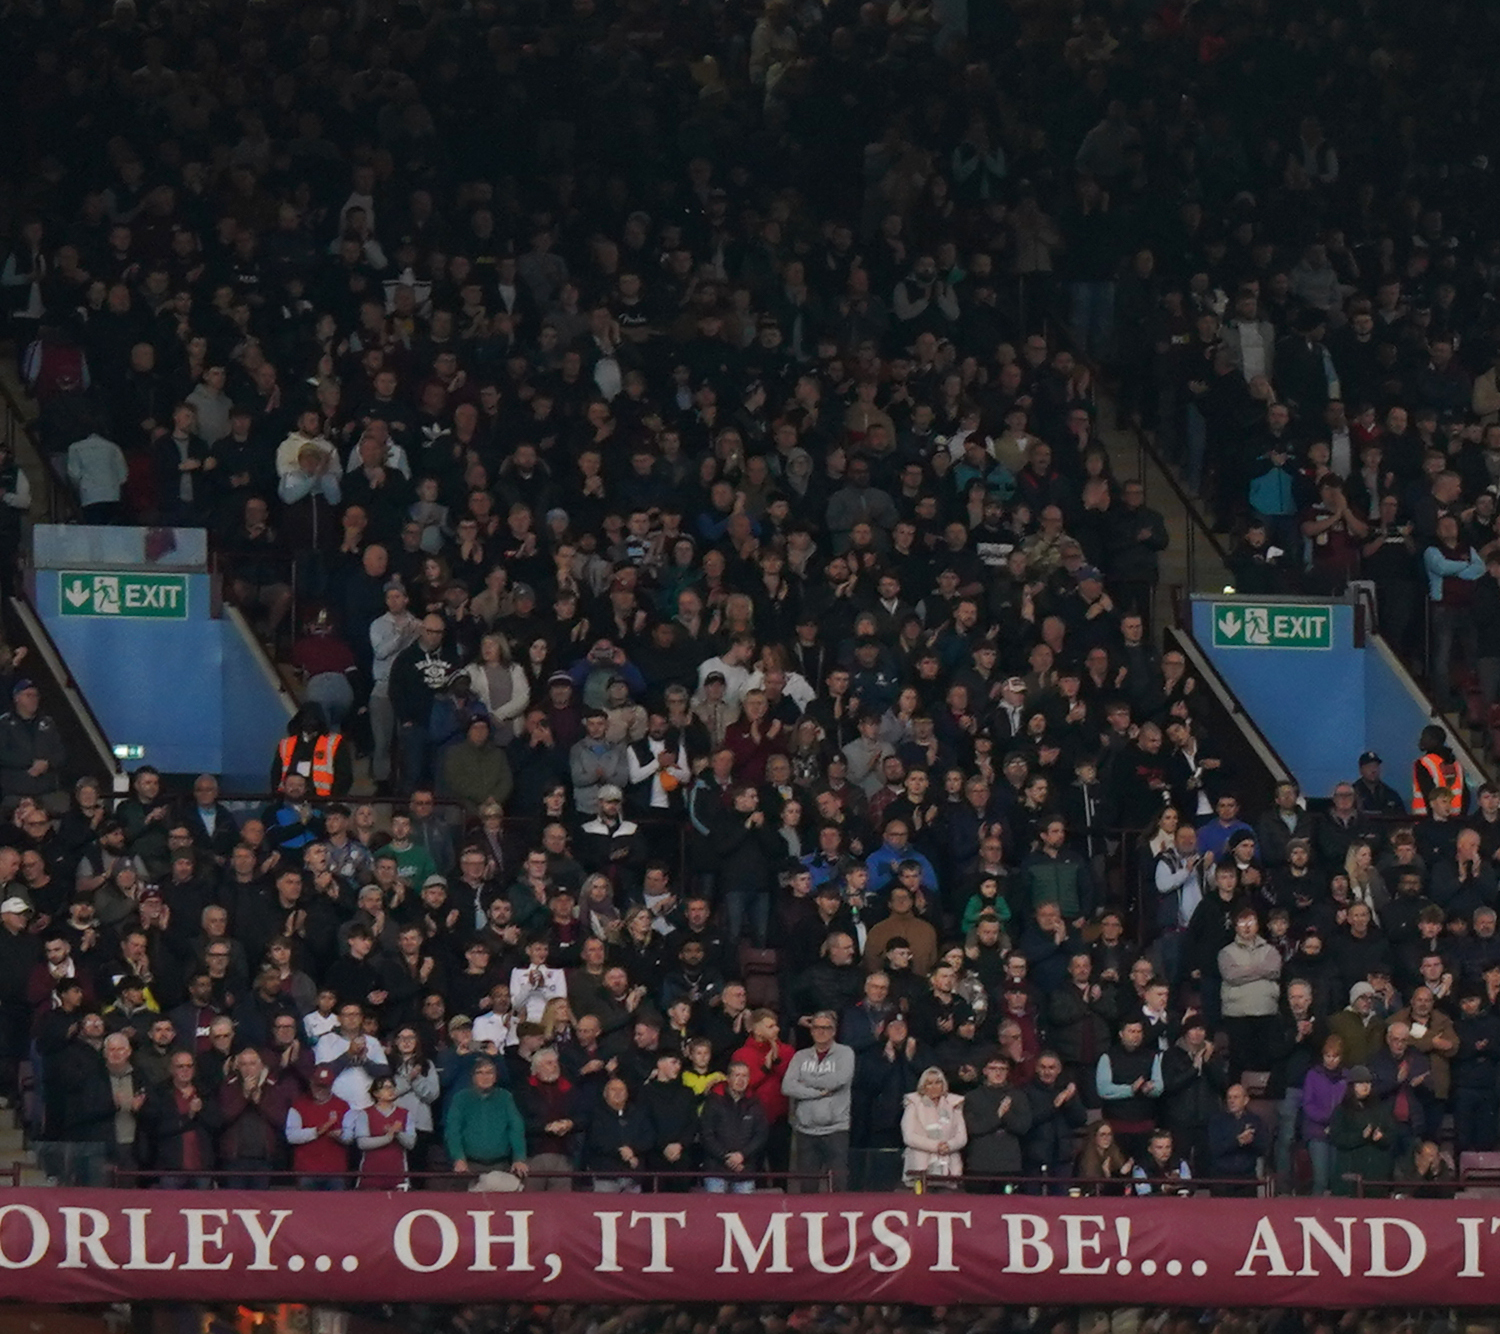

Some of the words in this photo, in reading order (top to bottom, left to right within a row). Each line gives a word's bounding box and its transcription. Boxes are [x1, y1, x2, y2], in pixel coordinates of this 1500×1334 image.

[125, 584, 182, 608] EXIT
[1274, 615, 1326, 638] EXIT
[0, 1205, 358, 1271] ORLEY...
[394, 1210, 561, 1281] OH,
[594, 1211, 685, 1271] IT
[716, 1210, 971, 1272] MUST
[1002, 1214, 1207, 1275] BE!...
[1236, 1217, 1426, 1276] AND
